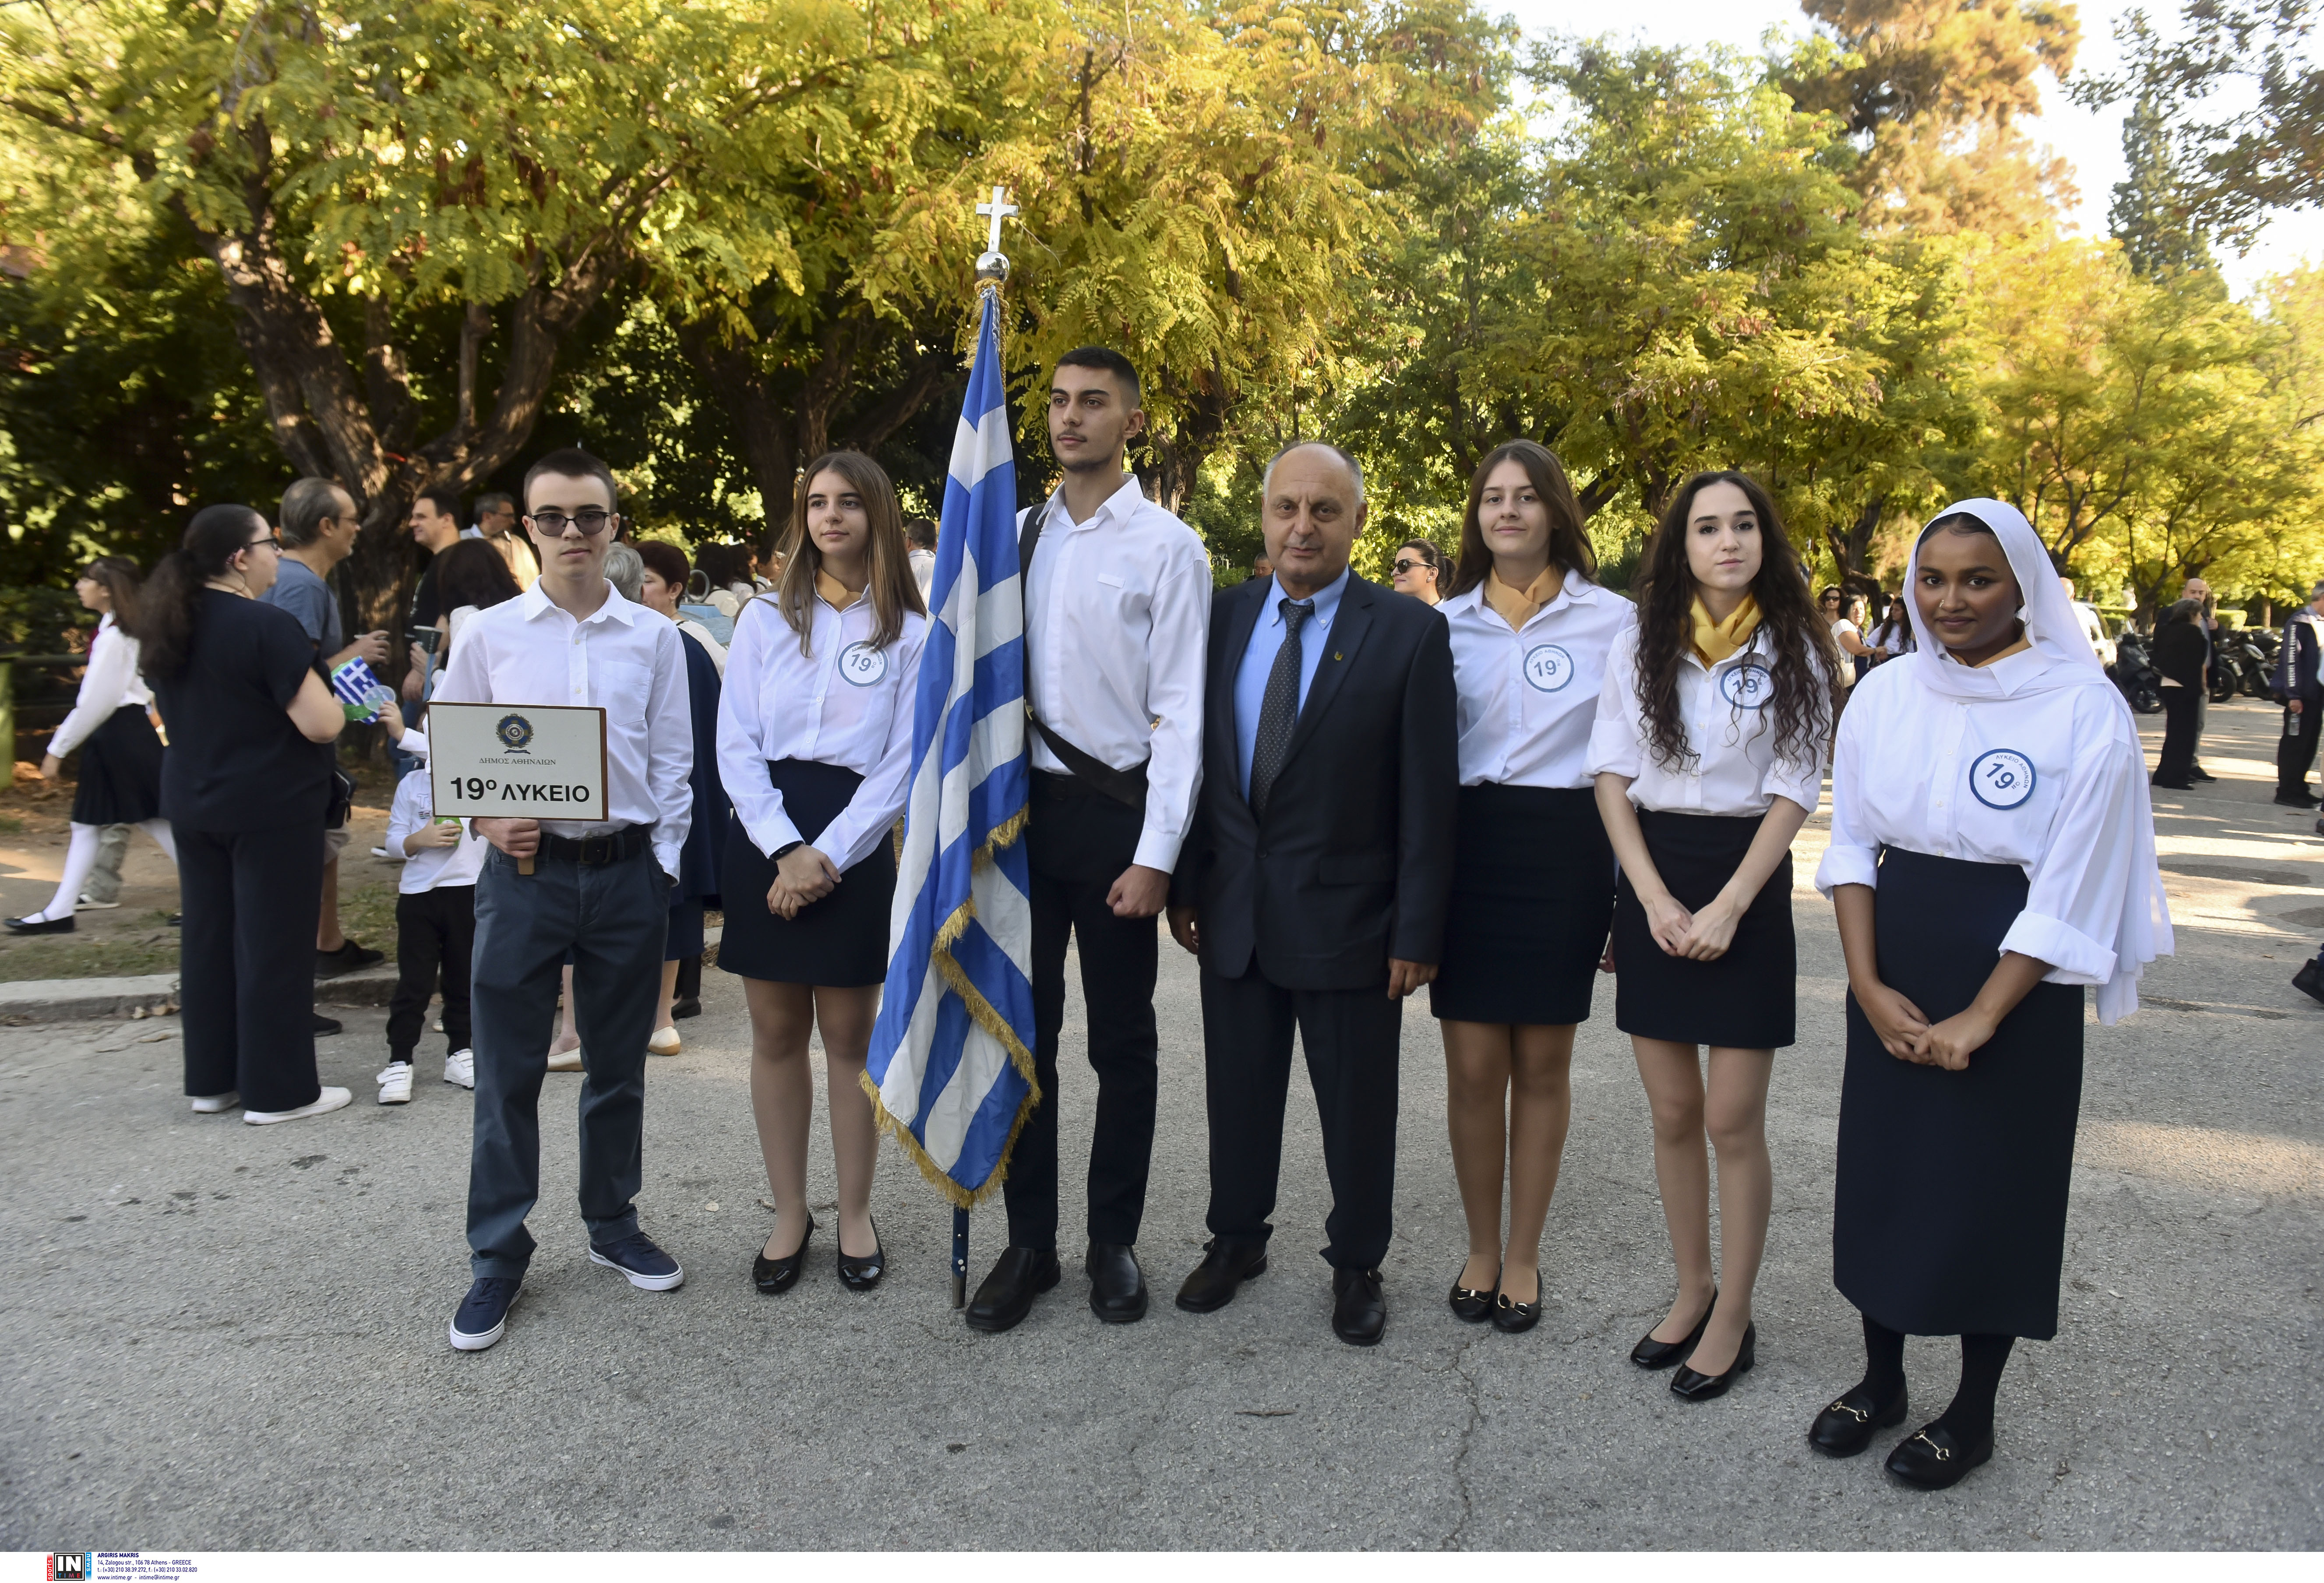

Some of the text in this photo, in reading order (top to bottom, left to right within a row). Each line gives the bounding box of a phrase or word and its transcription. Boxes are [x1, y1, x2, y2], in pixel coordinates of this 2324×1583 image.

[2289, 625, 2297, 646] COMPANY
[1545, 649, 1566, 658] ΑΘΗΝΩΝ
[2288, 646, 2296, 663] SUPPLY
[1996, 755, 2029, 788] ΛΥΚΕΙΟ ΑΘΗΝΩΝ
[501, 784, 590, 802] ΛΥΚΕΙΟ
